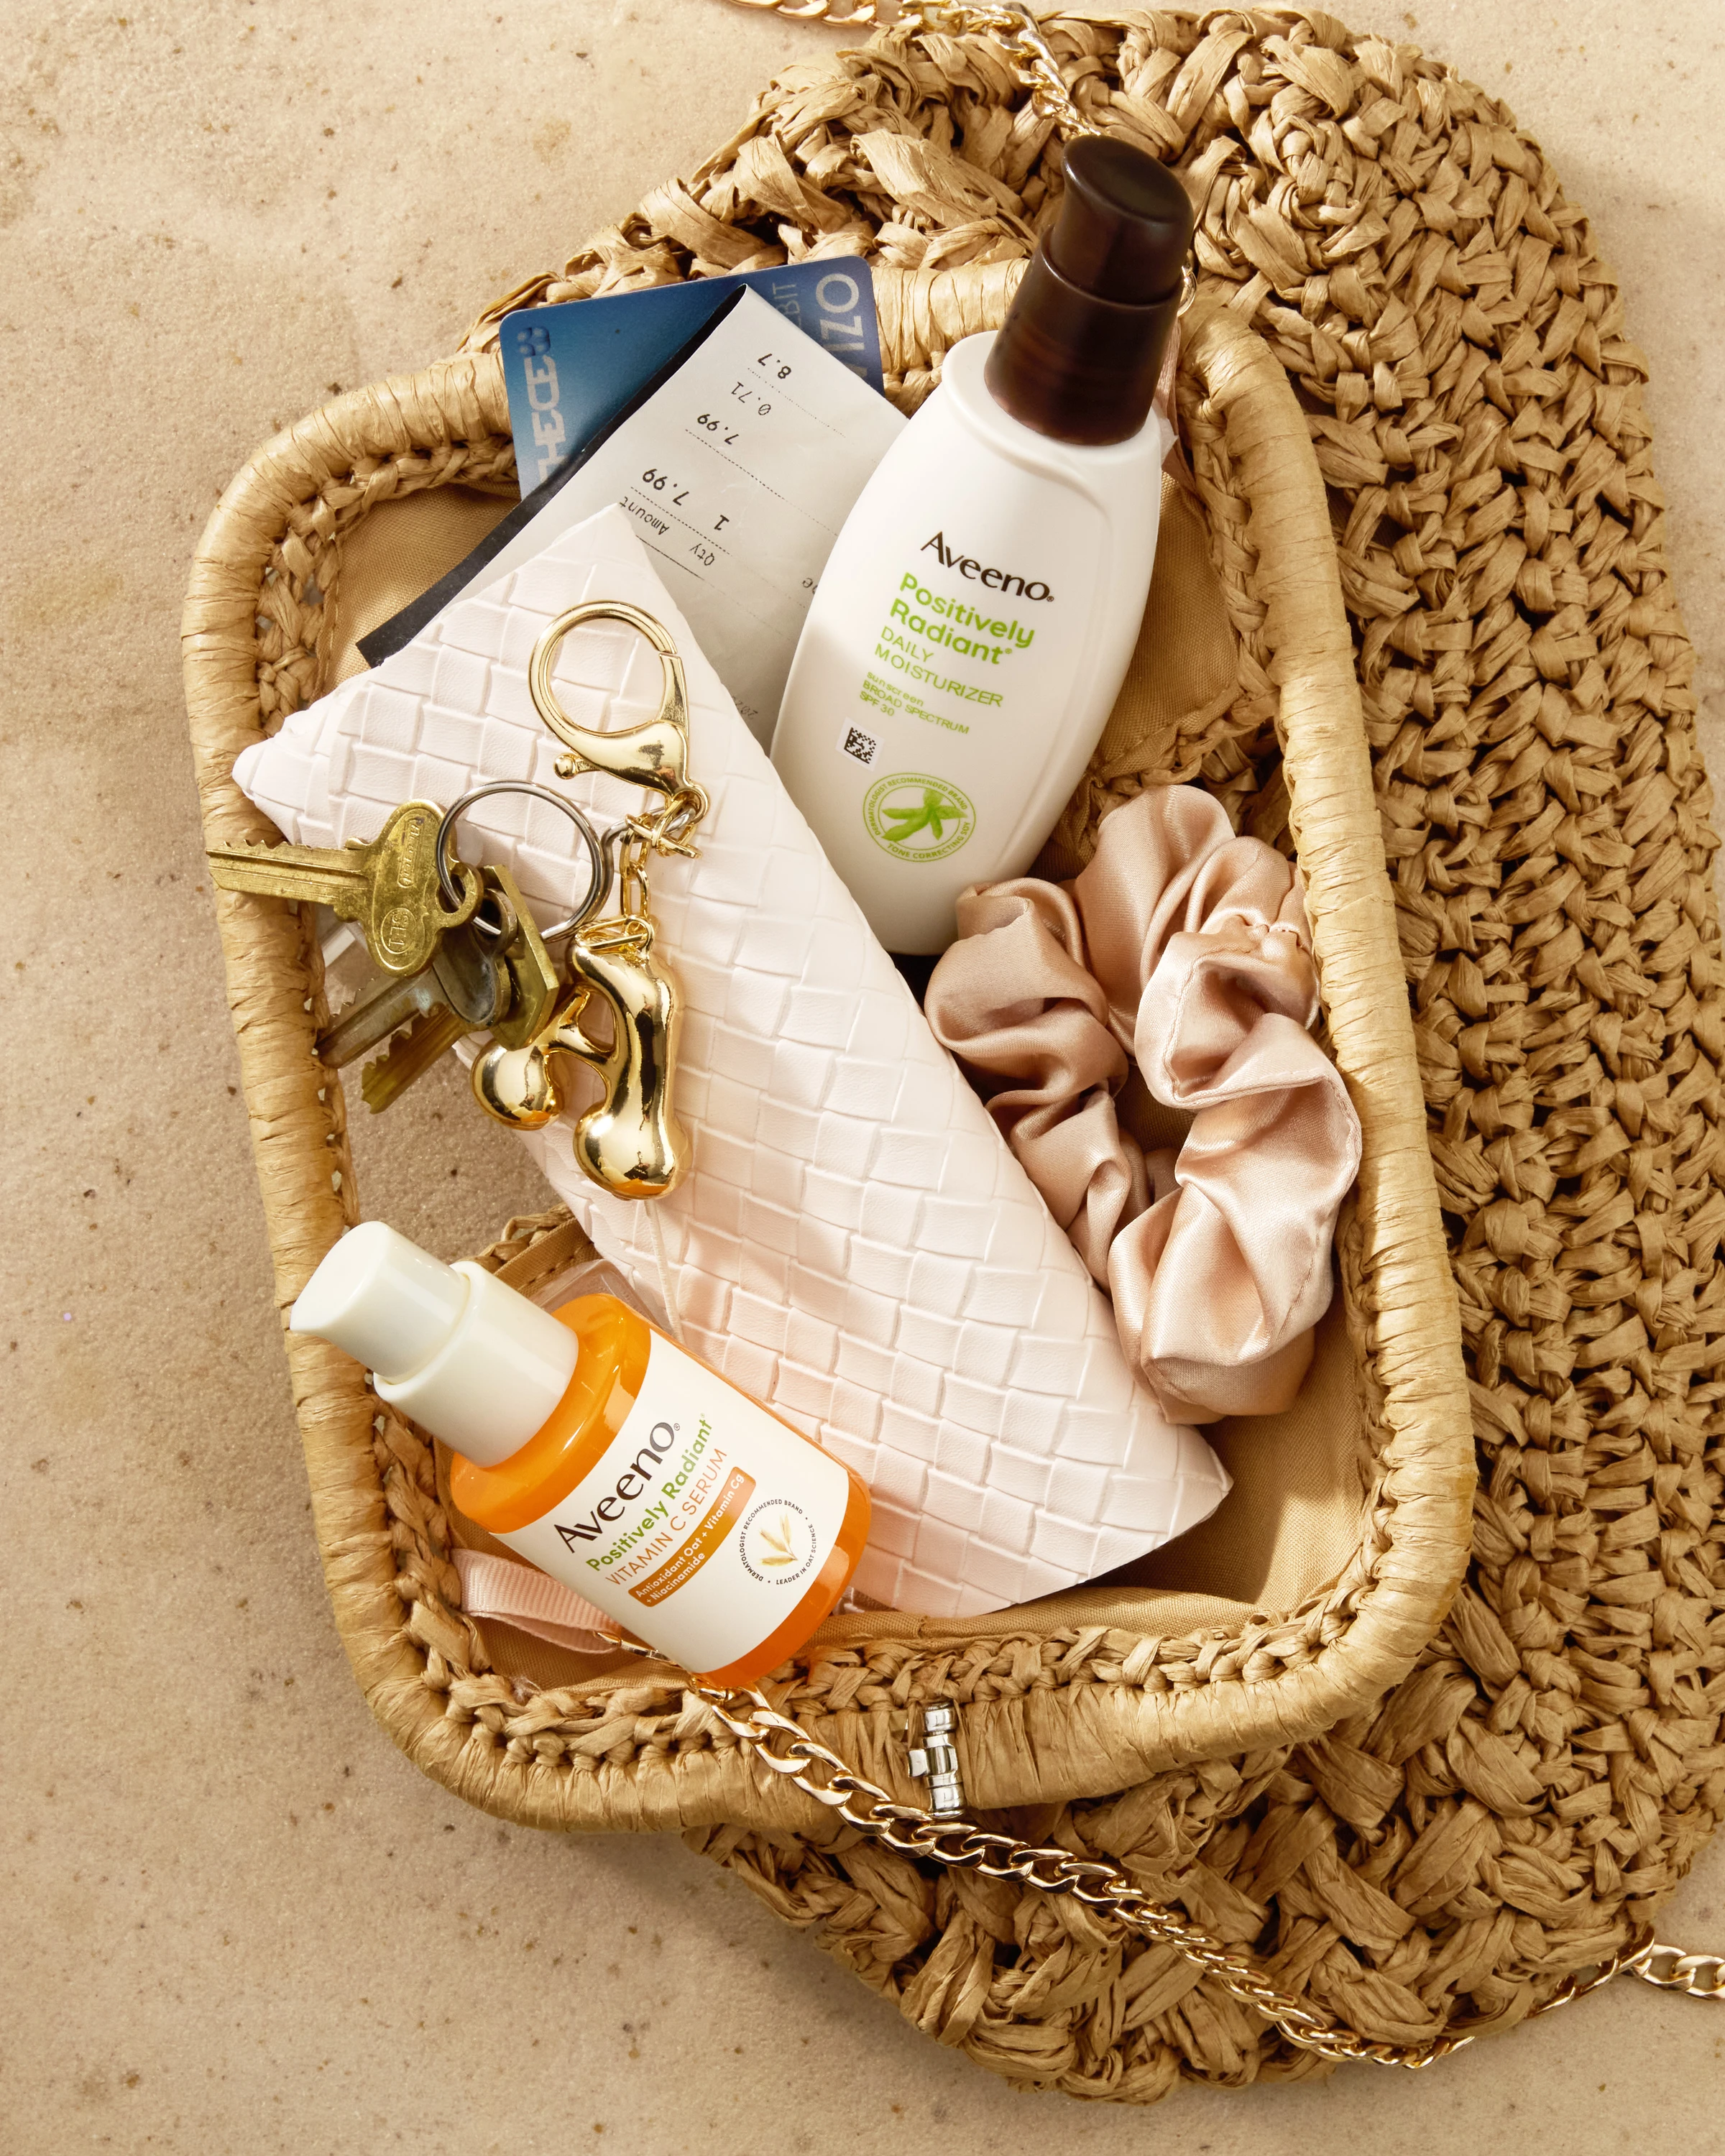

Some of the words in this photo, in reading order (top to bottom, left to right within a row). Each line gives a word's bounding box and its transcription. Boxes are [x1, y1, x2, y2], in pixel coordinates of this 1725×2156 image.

[773, 282, 801, 328] BIT
[758, 353, 792, 379] 8.7
[731, 381, 771, 415] 0.71
[697, 414, 740, 445] 7.99
[643, 468, 690, 507] 7.99
[620, 496, 670, 535] Amount
[714, 515, 730, 530] 1
[689, 543, 715, 566] Qty
[900, 572, 1035, 648] Positively
[880, 625, 934, 663] DAILY
[867, 671, 924, 707] sunscreen
[875, 643, 1003, 707] MOISTURIZER
[860, 690, 880, 706] SPF
[880, 703, 896, 717] 30
[862, 679, 903, 708] BROAD
[905, 704, 970, 734] SPECTRUM
[868, 784, 888, 837] DERMATOLOGIST
[887, 777, 948, 793] RECOMMENDED
[947, 790, 968, 811] BRAND
[886, 842, 911, 858] TONE
[912, 835, 965, 860] CORRECTING
[960, 821, 971, 837] SOY
[605, 1531, 673, 1585] VITAMIN
[670, 1515, 686, 1531] C
[681, 1448, 727, 1516] SERUM
[743, 1499, 783, 1530] RECOMMENDED
[783, 1500, 803, 1514] BRAND
[585, 1501, 669, 1572] Positively
[635, 1556, 686, 1598] Antioxidant
[684, 1537, 703, 1557] Oat
[704, 1491, 735, 1530] Vitamin
[808, 1524, 816, 1554] SCIENCE
[739, 1531, 764, 1582] DERMATOLOGIST
[799, 1567, 807, 1575] IN
[806, 1554, 814, 1567] OAT
[649, 1552, 705, 1600] Niacinamide
[776, 1572, 800, 1585] LEADER
